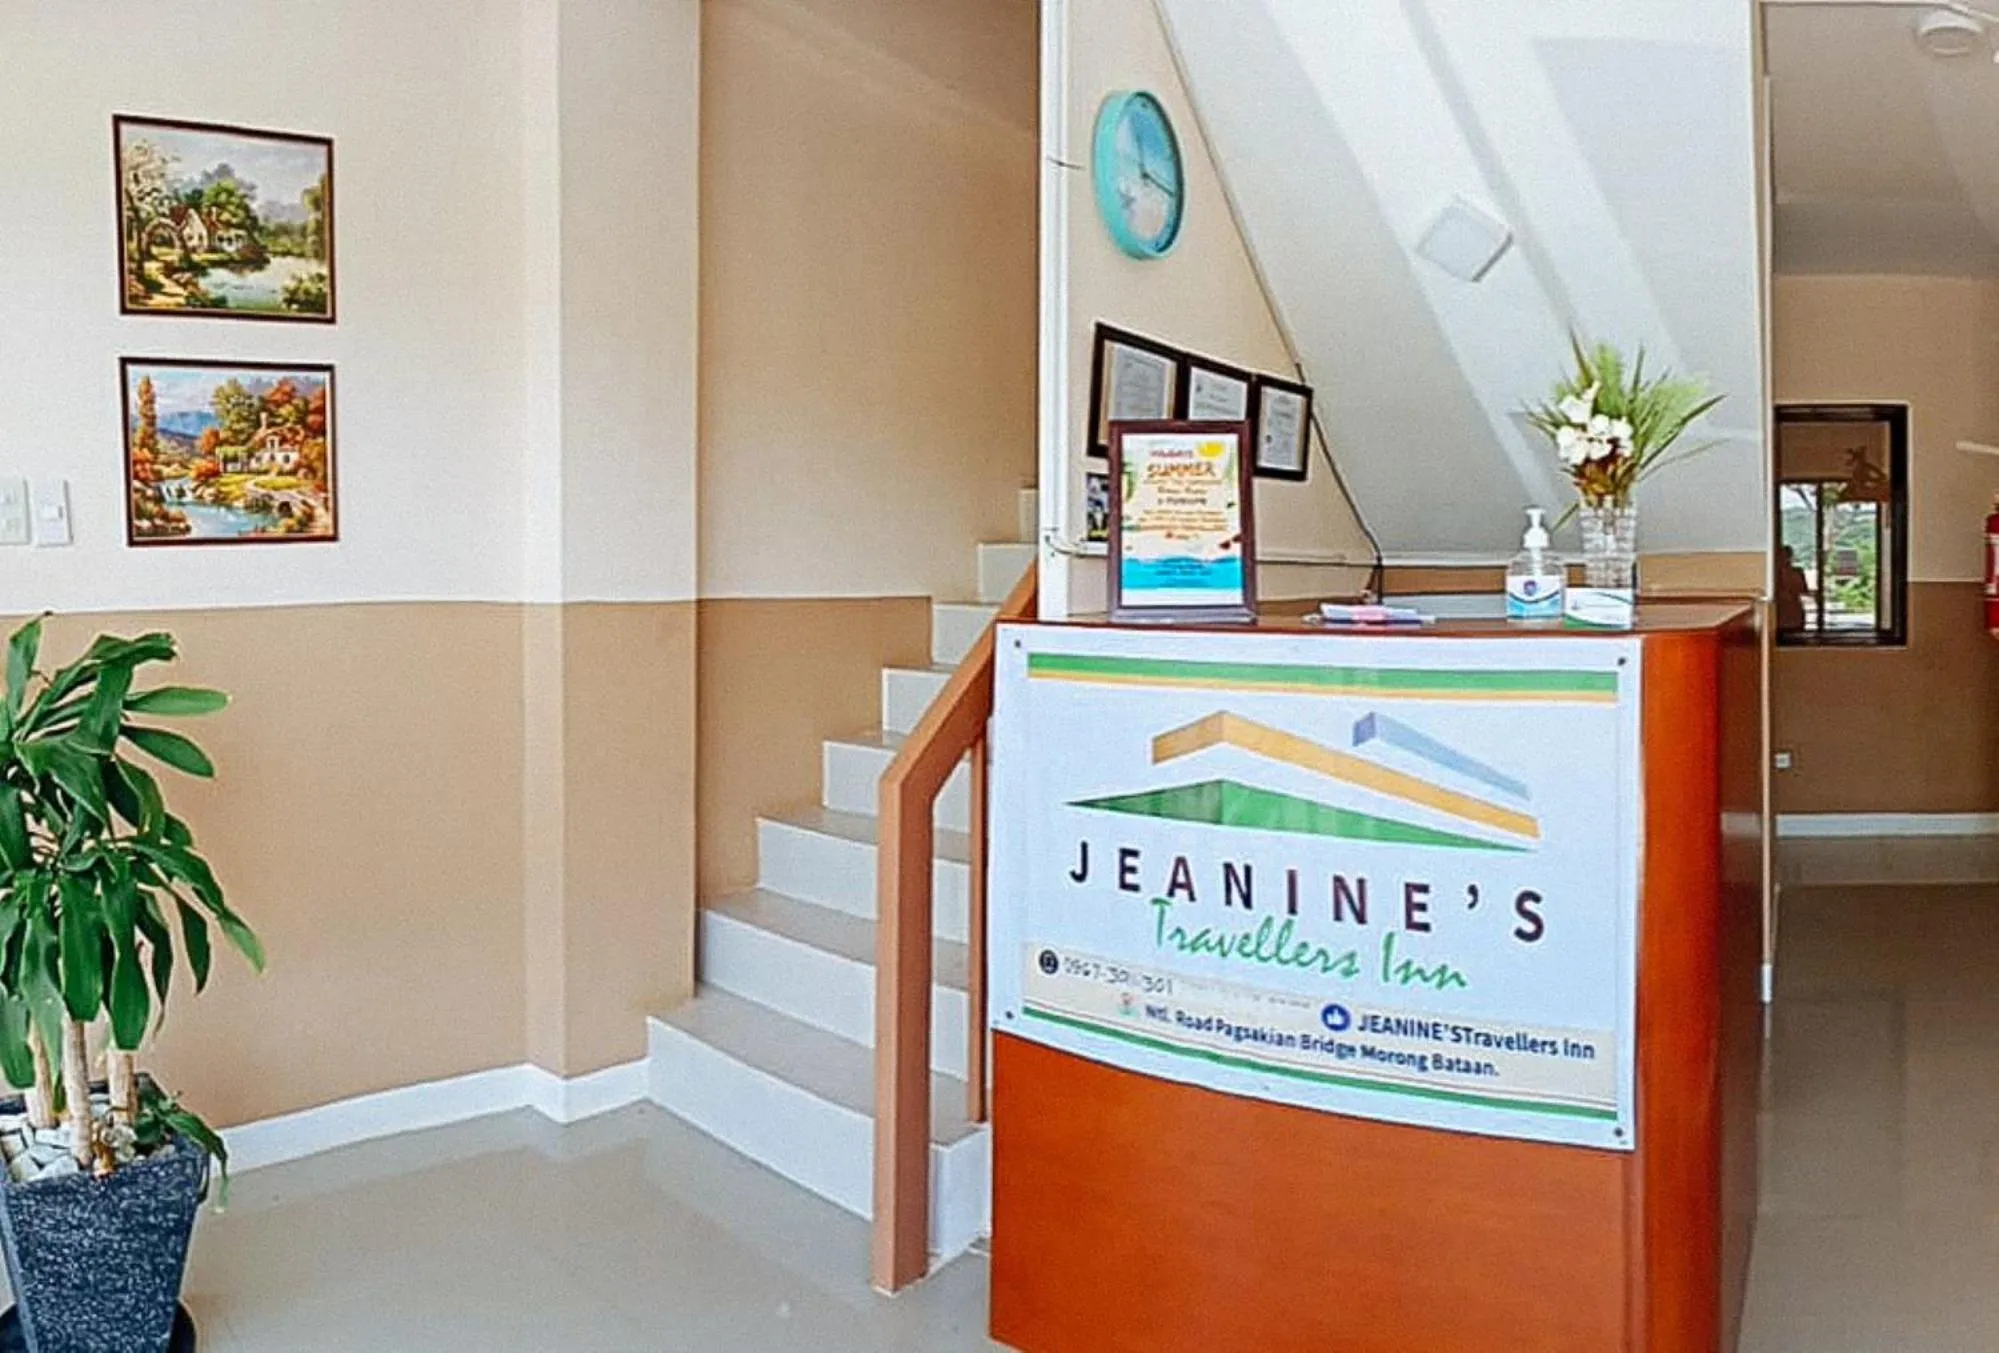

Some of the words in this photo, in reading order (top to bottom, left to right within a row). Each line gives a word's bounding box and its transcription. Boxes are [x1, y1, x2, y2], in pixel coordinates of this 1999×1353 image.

[1070, 841, 1545, 943] JEANINE'S
[1151, 897, 1360, 978] Travellers
[1380, 931, 1468, 990] Inn
[1176, 1010, 1213, 1033] Road
[1301, 1034, 1357, 1060] Bridge
[1360, 1045, 1429, 1073] Morong
[1563, 1037, 1596, 1060] Inn
